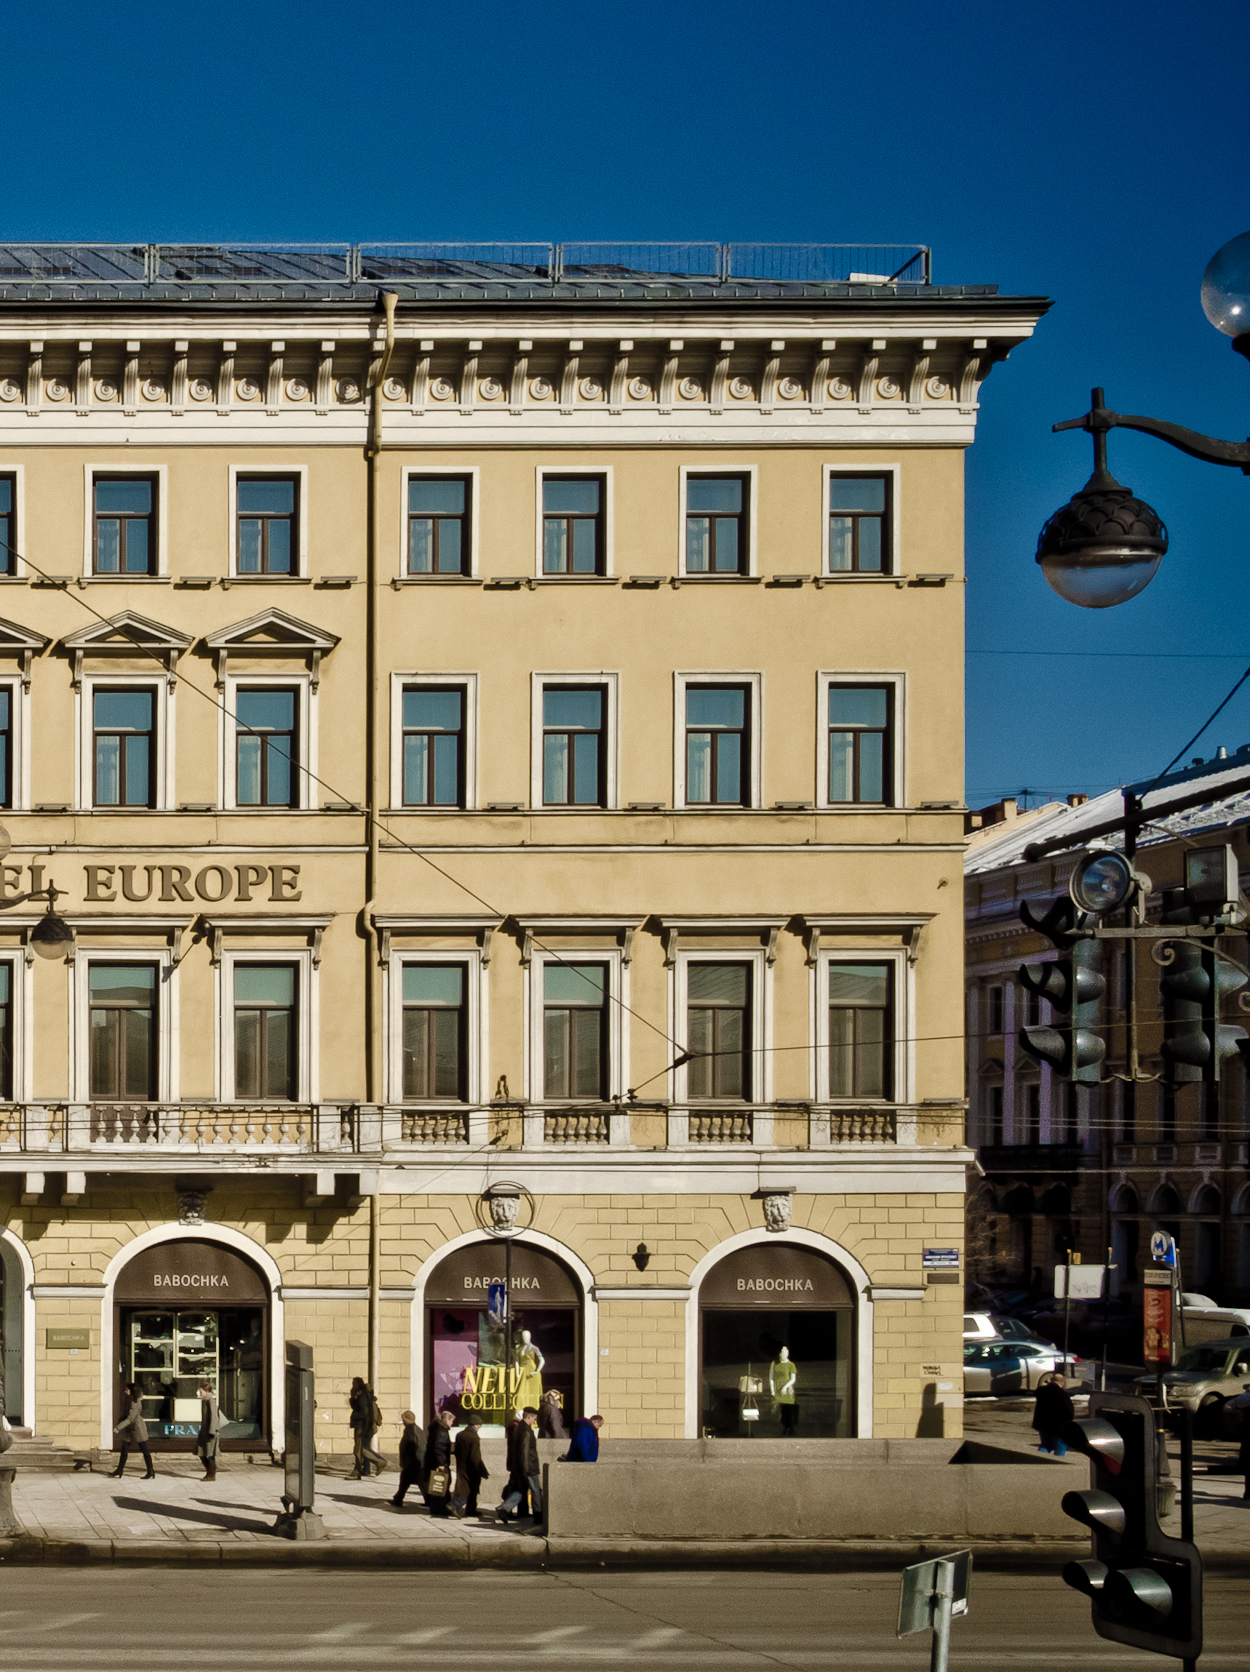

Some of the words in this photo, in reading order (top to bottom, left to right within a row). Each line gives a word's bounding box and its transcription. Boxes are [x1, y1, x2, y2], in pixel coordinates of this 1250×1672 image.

[83, 864, 303, 902] EUROPE
[153, 1274, 229, 1287] BABOCHKA
[737, 1278, 814, 1291] BABOCHKA
[463, 1366, 526, 1394] NEW
[164, 1424, 202, 1436] PRA
